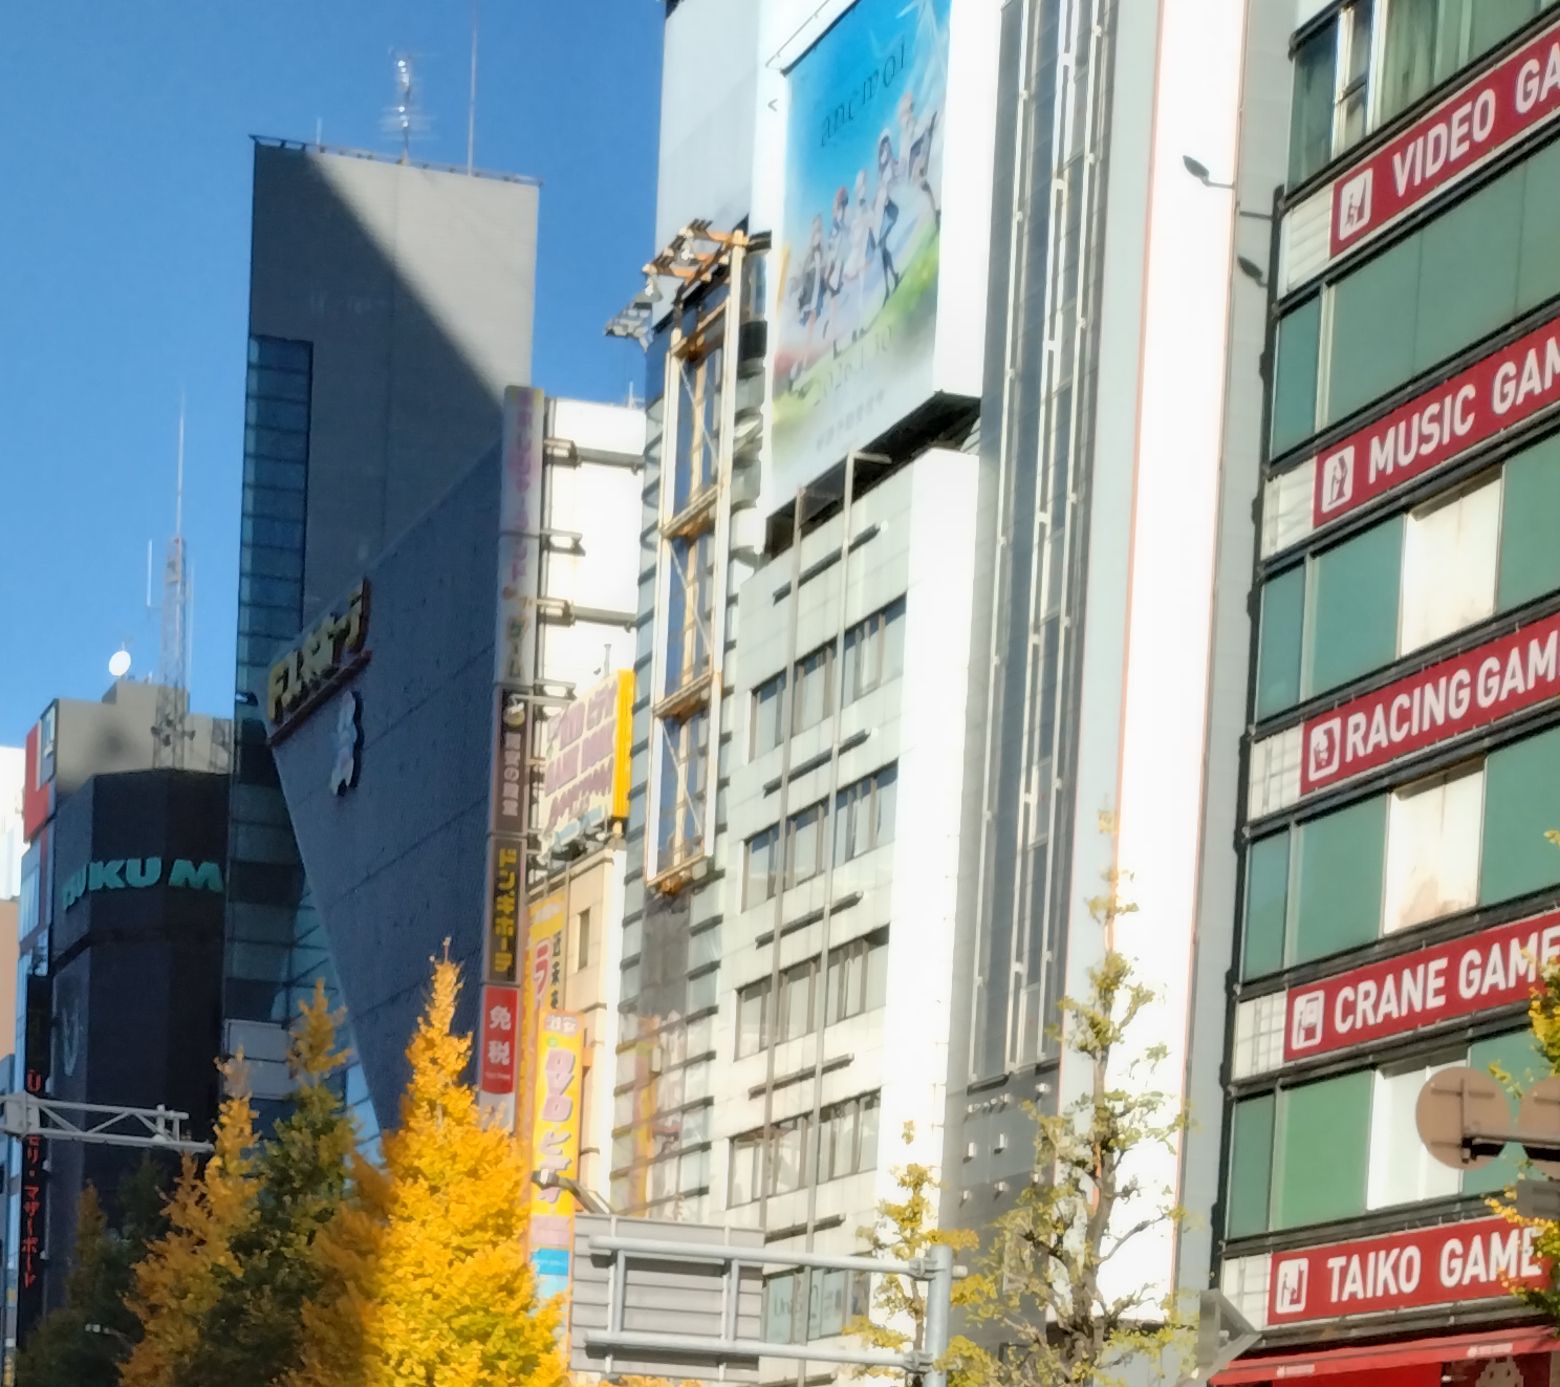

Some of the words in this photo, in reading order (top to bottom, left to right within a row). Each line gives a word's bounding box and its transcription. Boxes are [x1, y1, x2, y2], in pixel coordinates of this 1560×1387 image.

[1392, 88, 1496, 198] VIDEO
[1368, 385, 1477, 484] MUSIC
[1345, 668, 1471, 763] RACING
[488, 1004, 512, 1066] 免税
[1334, 957, 1448, 1035] CRANE
[1327, 1245, 1421, 1303] TAIKO
